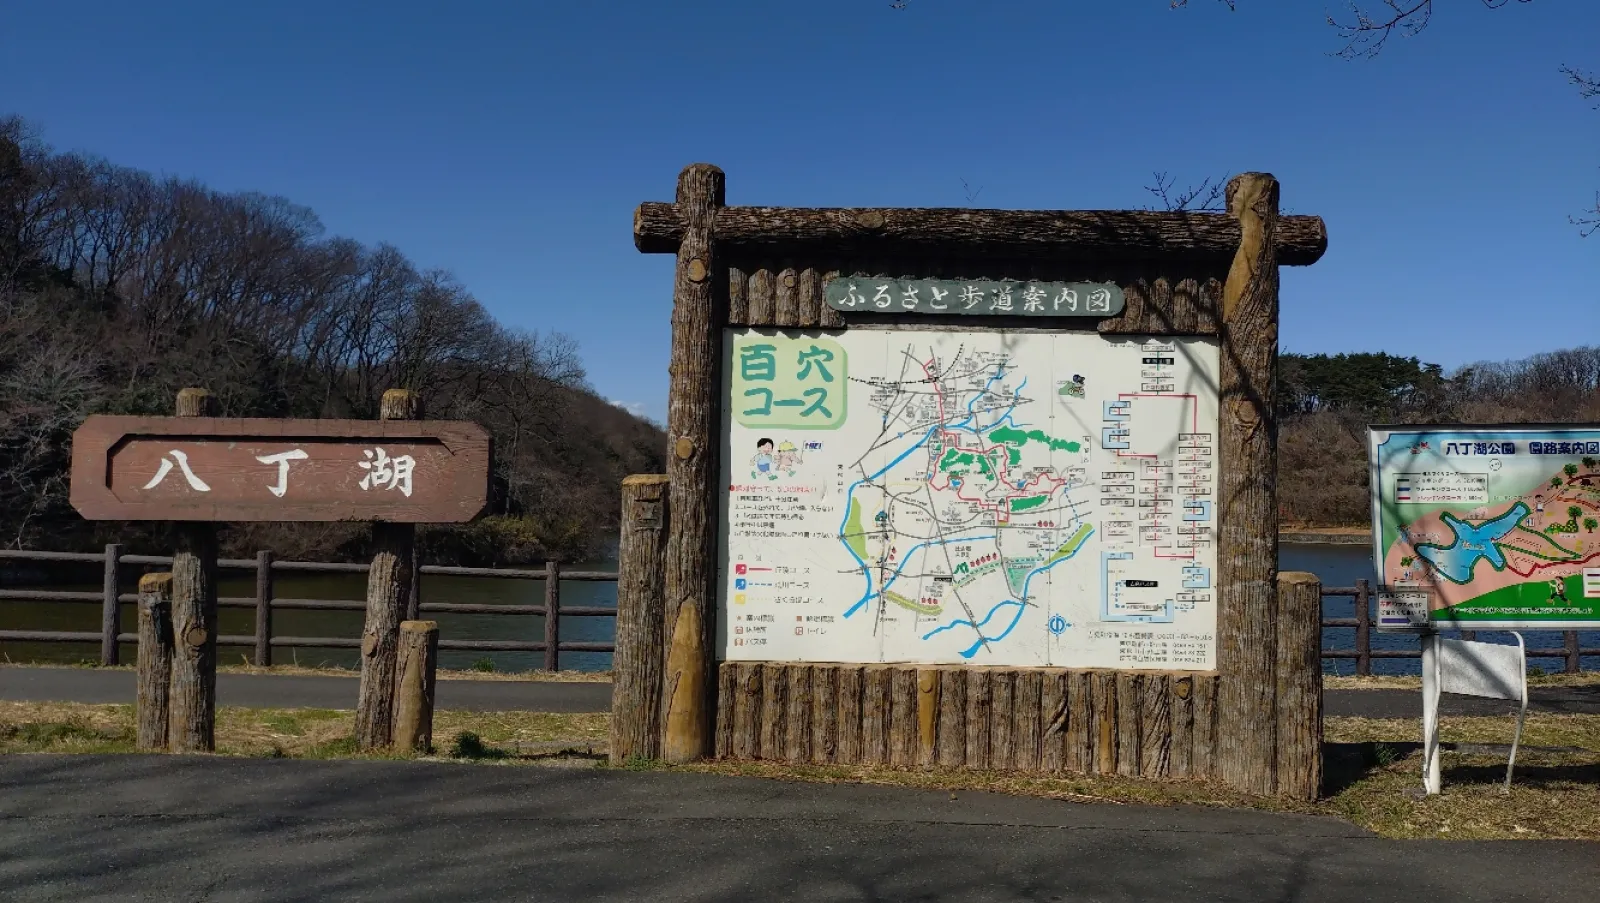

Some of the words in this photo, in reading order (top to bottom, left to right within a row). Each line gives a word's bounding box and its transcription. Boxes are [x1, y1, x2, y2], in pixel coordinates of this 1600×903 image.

[838, 285, 1111, 312] ふるさと歩道案内図
[743, 387, 833, 418] コース
[1446, 442, 1515, 456] 八丁湖公園
[1529, 441, 1599, 455] 園路案内図
[143, 446, 416, 497] 八丁湖
